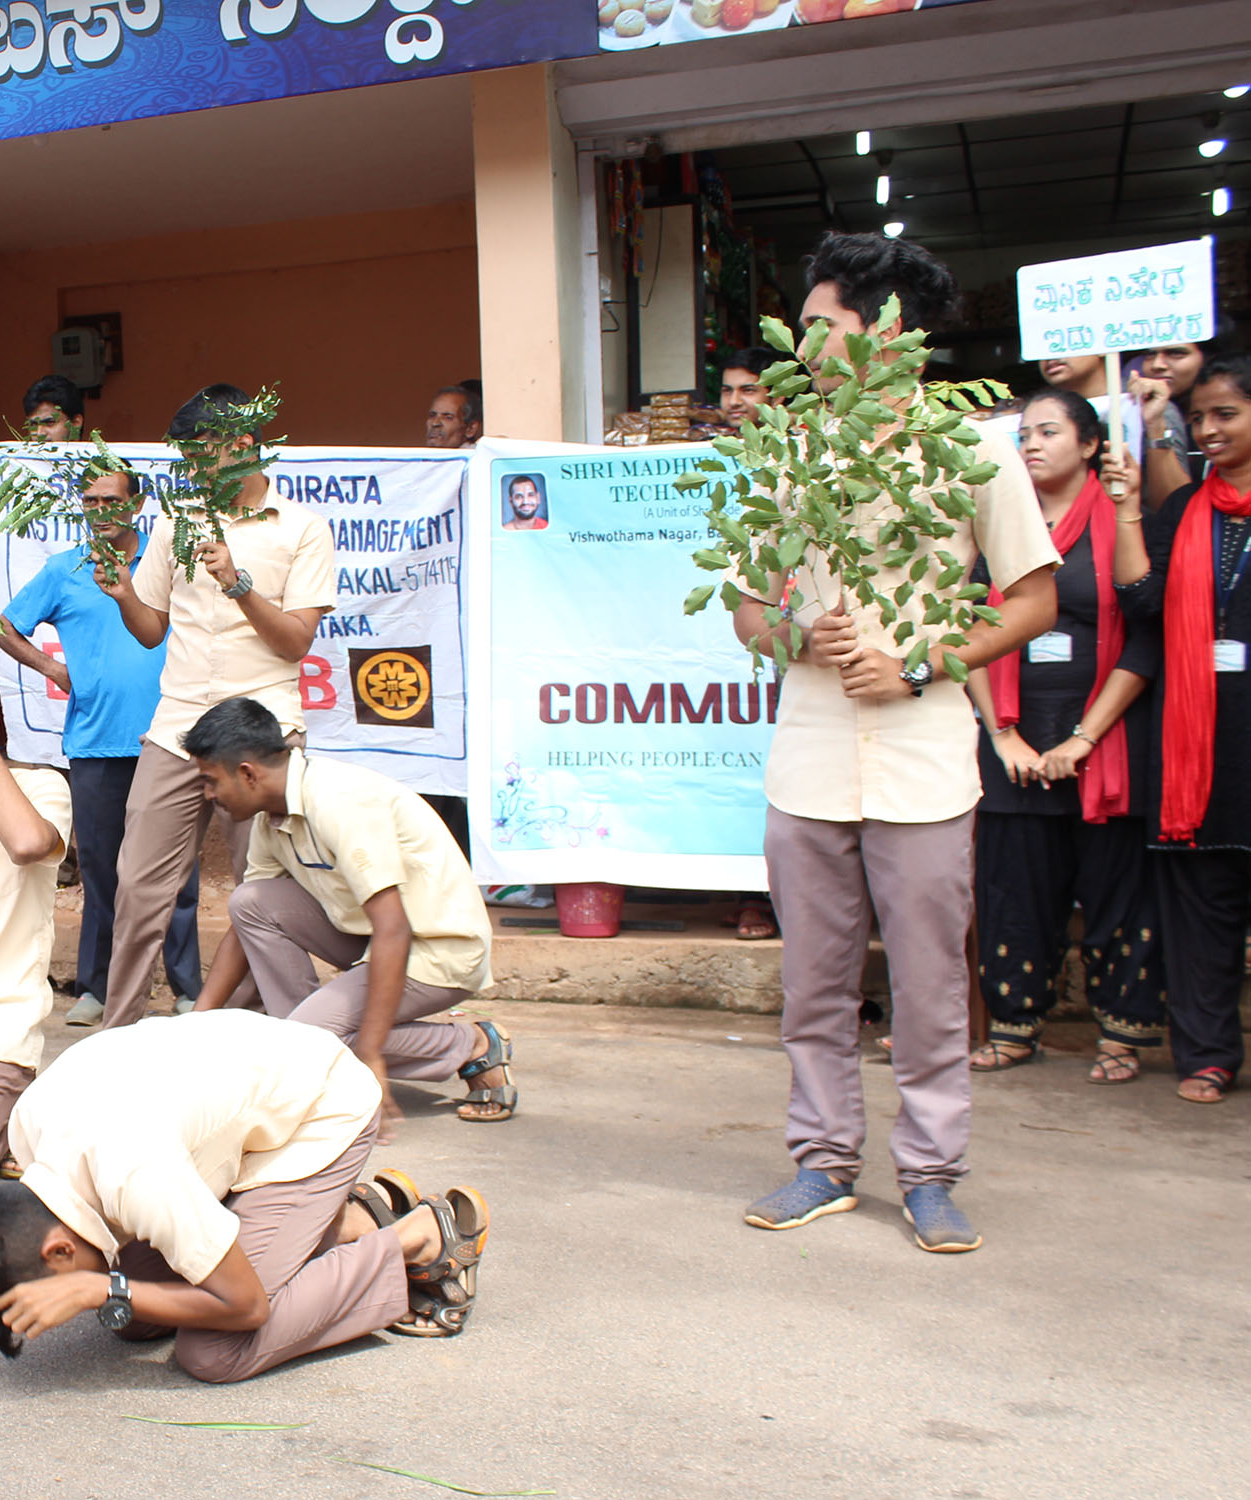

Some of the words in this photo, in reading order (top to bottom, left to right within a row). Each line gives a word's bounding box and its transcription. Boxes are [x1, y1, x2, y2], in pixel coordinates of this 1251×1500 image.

[1044, 325, 1095, 353] ಇದು
[560, 461, 613, 481] SHRI
[276, 475, 382, 506] DIRAJA
[644, 507, 654, 519] (A
[656, 506, 678, 518] Unit
[680, 505, 692, 517] of
[569, 529, 654, 544] Vishwothama
[658, 527, 703, 545] Nagar,
[334, 556, 457, 595] AKAL-574115
[539, 682, 777, 725] COMMU
[547, 750, 633, 768] HELPING
[641, 750, 716, 768] PEOPLE
[721, 750, 762, 768] CAN
